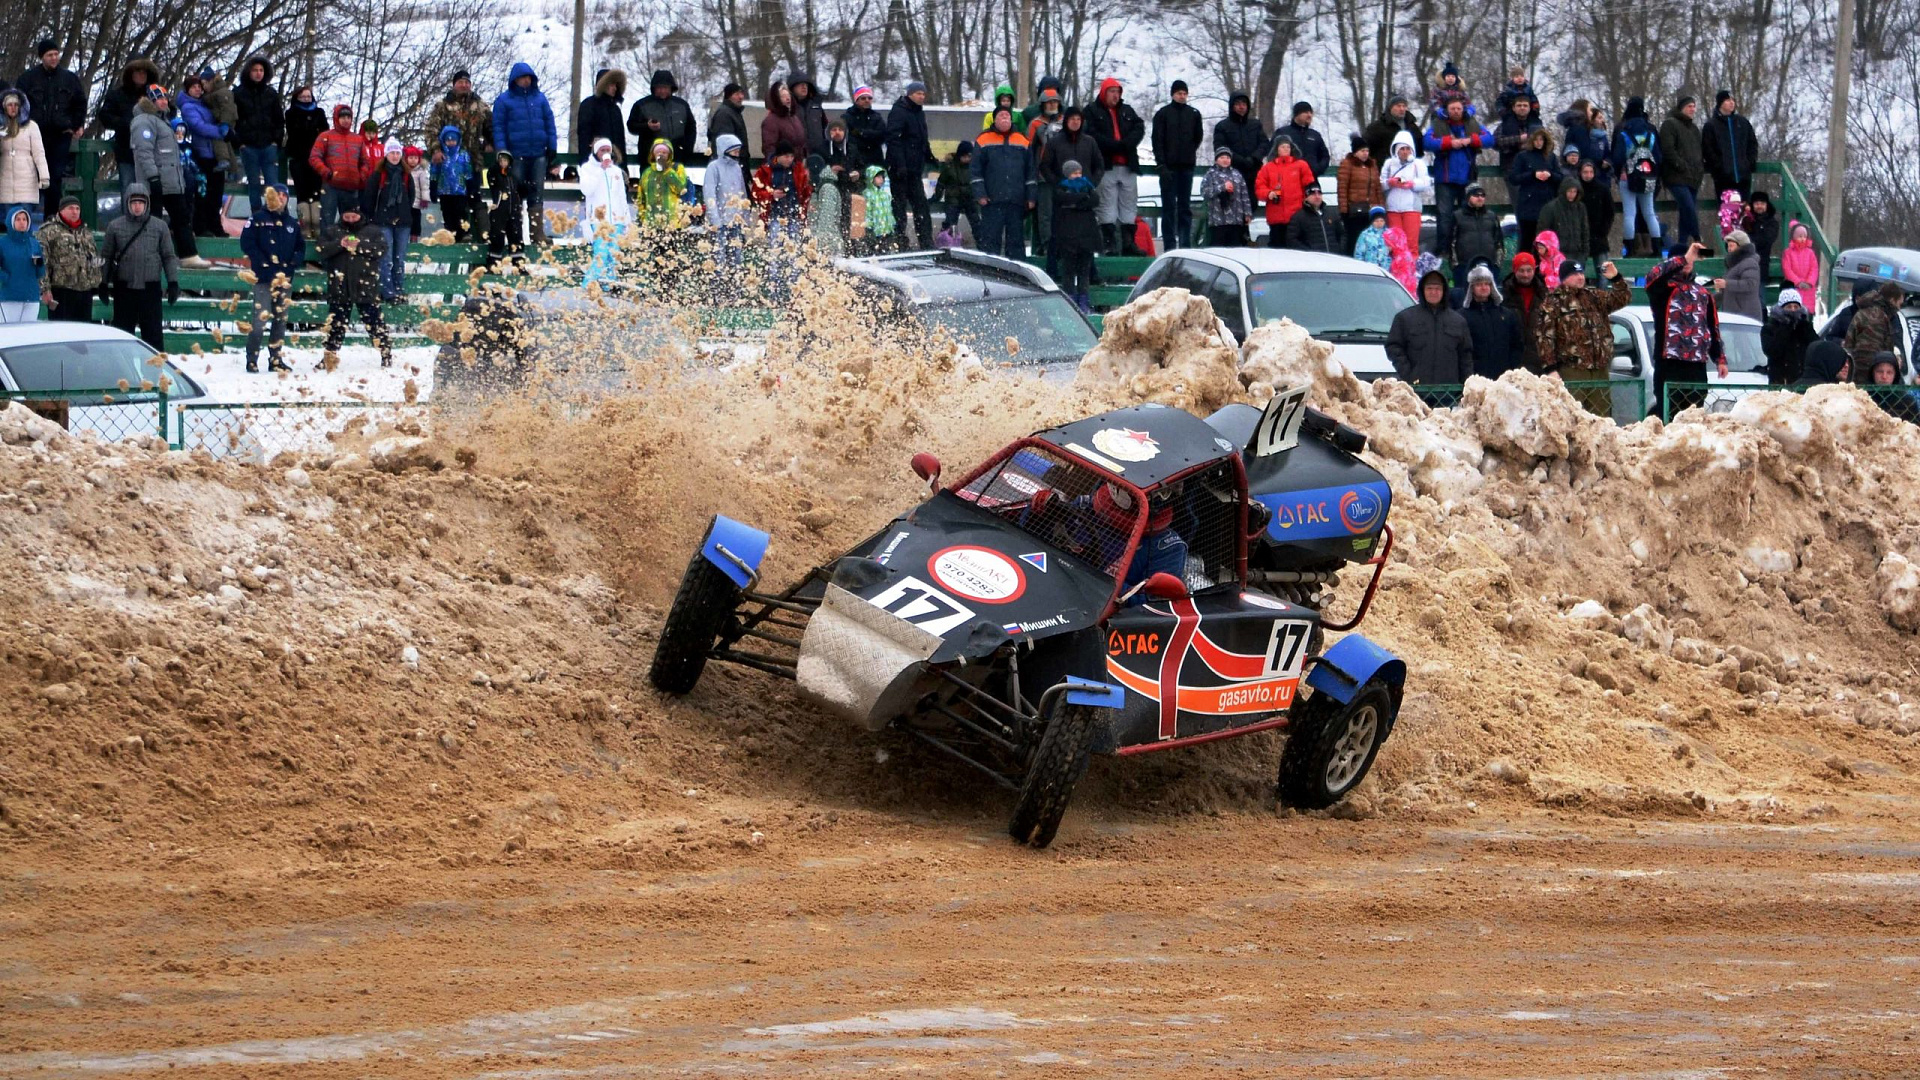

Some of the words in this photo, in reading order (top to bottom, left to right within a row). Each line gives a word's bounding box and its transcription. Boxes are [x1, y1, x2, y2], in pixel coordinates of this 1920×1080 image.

[1269, 391, 1305, 446] 17
[1296, 502, 1330, 525] ГАС
[943, 563, 965, 577] 970
[966, 576, 995, 594] 4282
[882, 587, 960, 624] 17
[1019, 618, 1058, 632] Мишин
[1126, 632, 1159, 655] ГАС
[1270, 624, 1308, 671] 17
[1217, 684, 1291, 712] gasavto.ru
